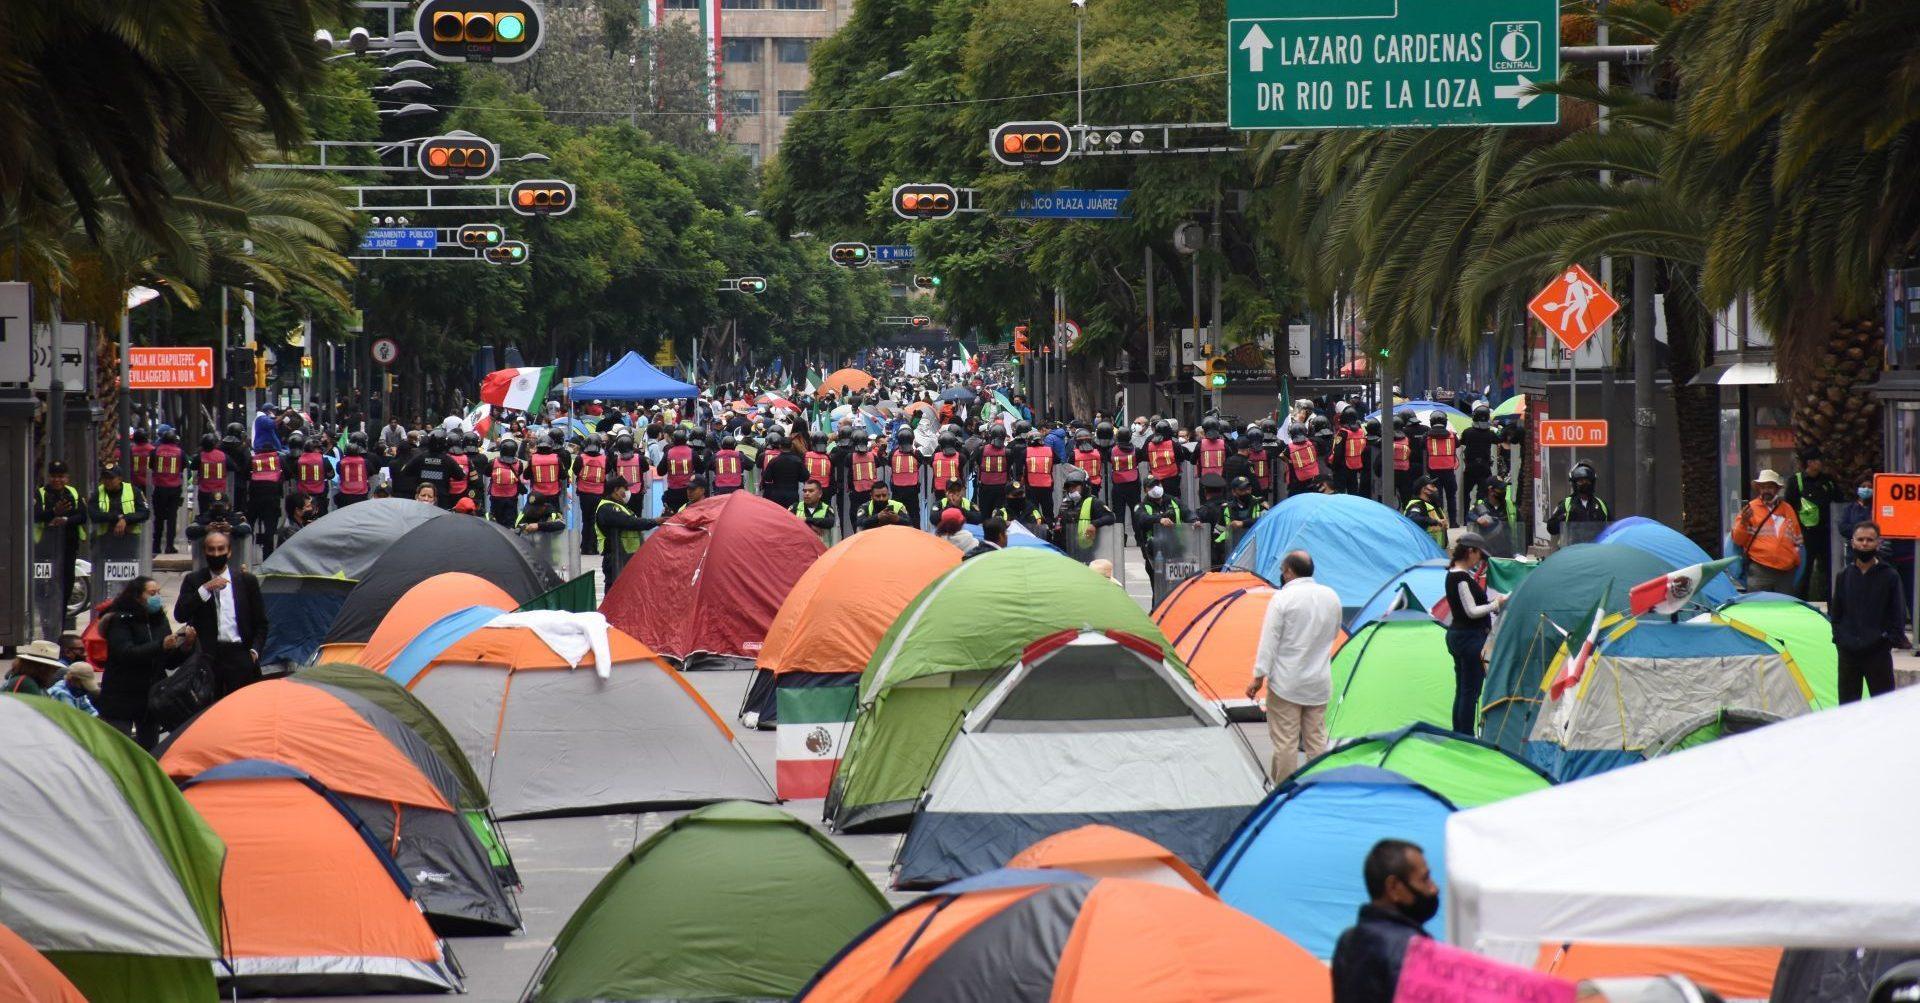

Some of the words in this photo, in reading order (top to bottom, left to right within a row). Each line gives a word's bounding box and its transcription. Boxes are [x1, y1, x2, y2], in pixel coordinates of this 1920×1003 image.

[1506, 24, 1524, 33] EJE
[1280, 35, 1363, 66] LAZARO
[1374, 32, 1483, 63] CARDENAS
[1495, 61, 1535, 70] CENTRAL
[1257, 82, 1285, 111] DR
[1297, 81, 1333, 110] RIO
[1346, 80, 1373, 110] DE
[1386, 80, 1413, 109] LA
[1425, 79, 1482, 108] LOZA
[1056, 198, 1083, 210] PLAZA
[1086, 195, 1118, 210] JUÁREZ
[130, 354, 147, 366] HACIA
[157, 353, 195, 366] CHAPULTEPEC
[128, 370, 170, 382] EVILLAGIGEDO
[1546, 426, 1555, 440] A
[1561, 425, 1584, 441] 100
[1590, 428, 1602, 440] m
[1890, 483, 1920, 502] OB
[106, 565, 136, 578] POLICIA
